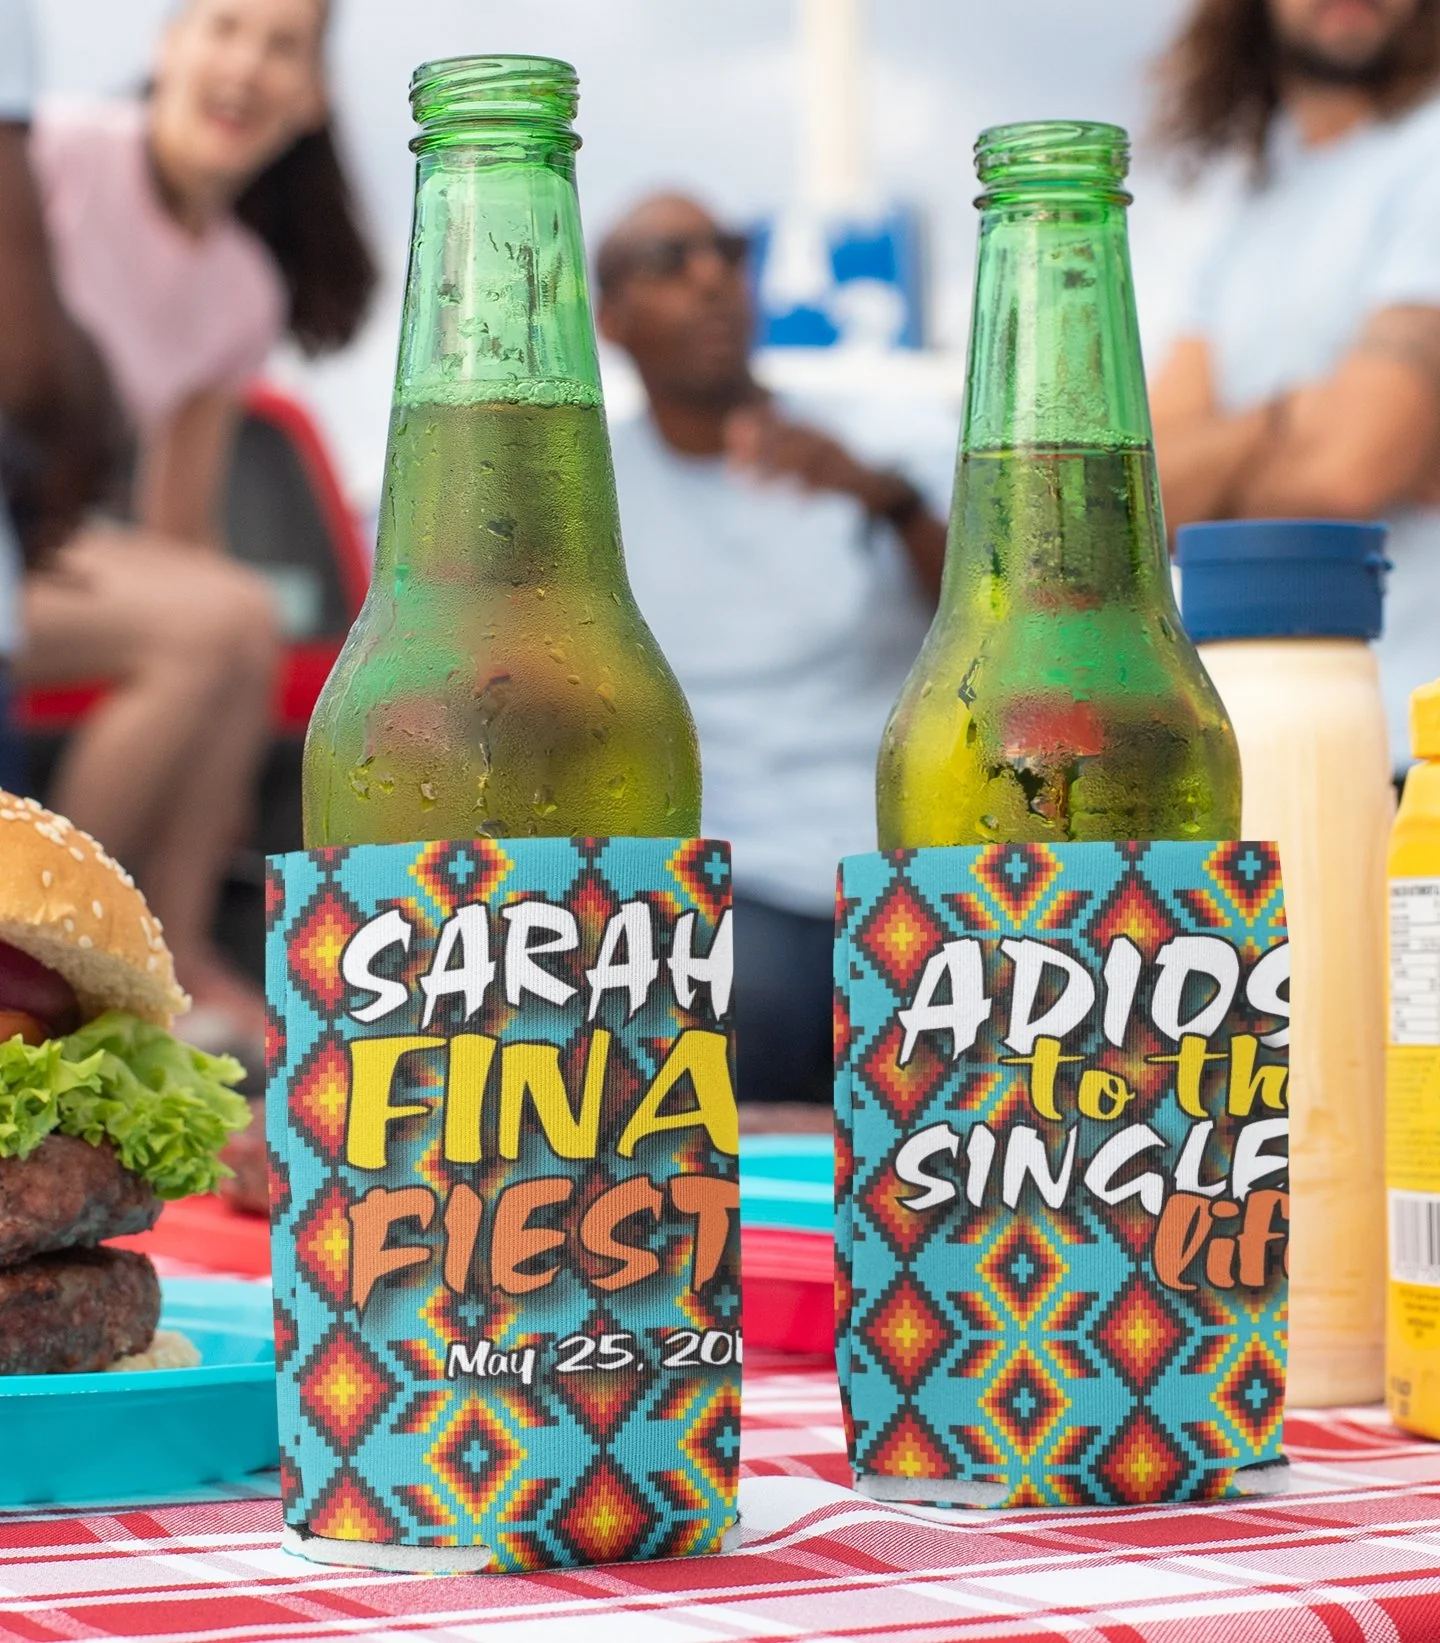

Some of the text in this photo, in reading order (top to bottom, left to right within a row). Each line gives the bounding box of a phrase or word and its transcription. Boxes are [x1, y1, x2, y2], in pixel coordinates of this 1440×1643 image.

[342, 901, 734, 1027] SARAH
[1001, 1035, 1136, 1120] to
[1148, 1034, 1290, 1117] th
[1154, 1189, 1290, 1291] lif
[447, 1341, 536, 1384] May
